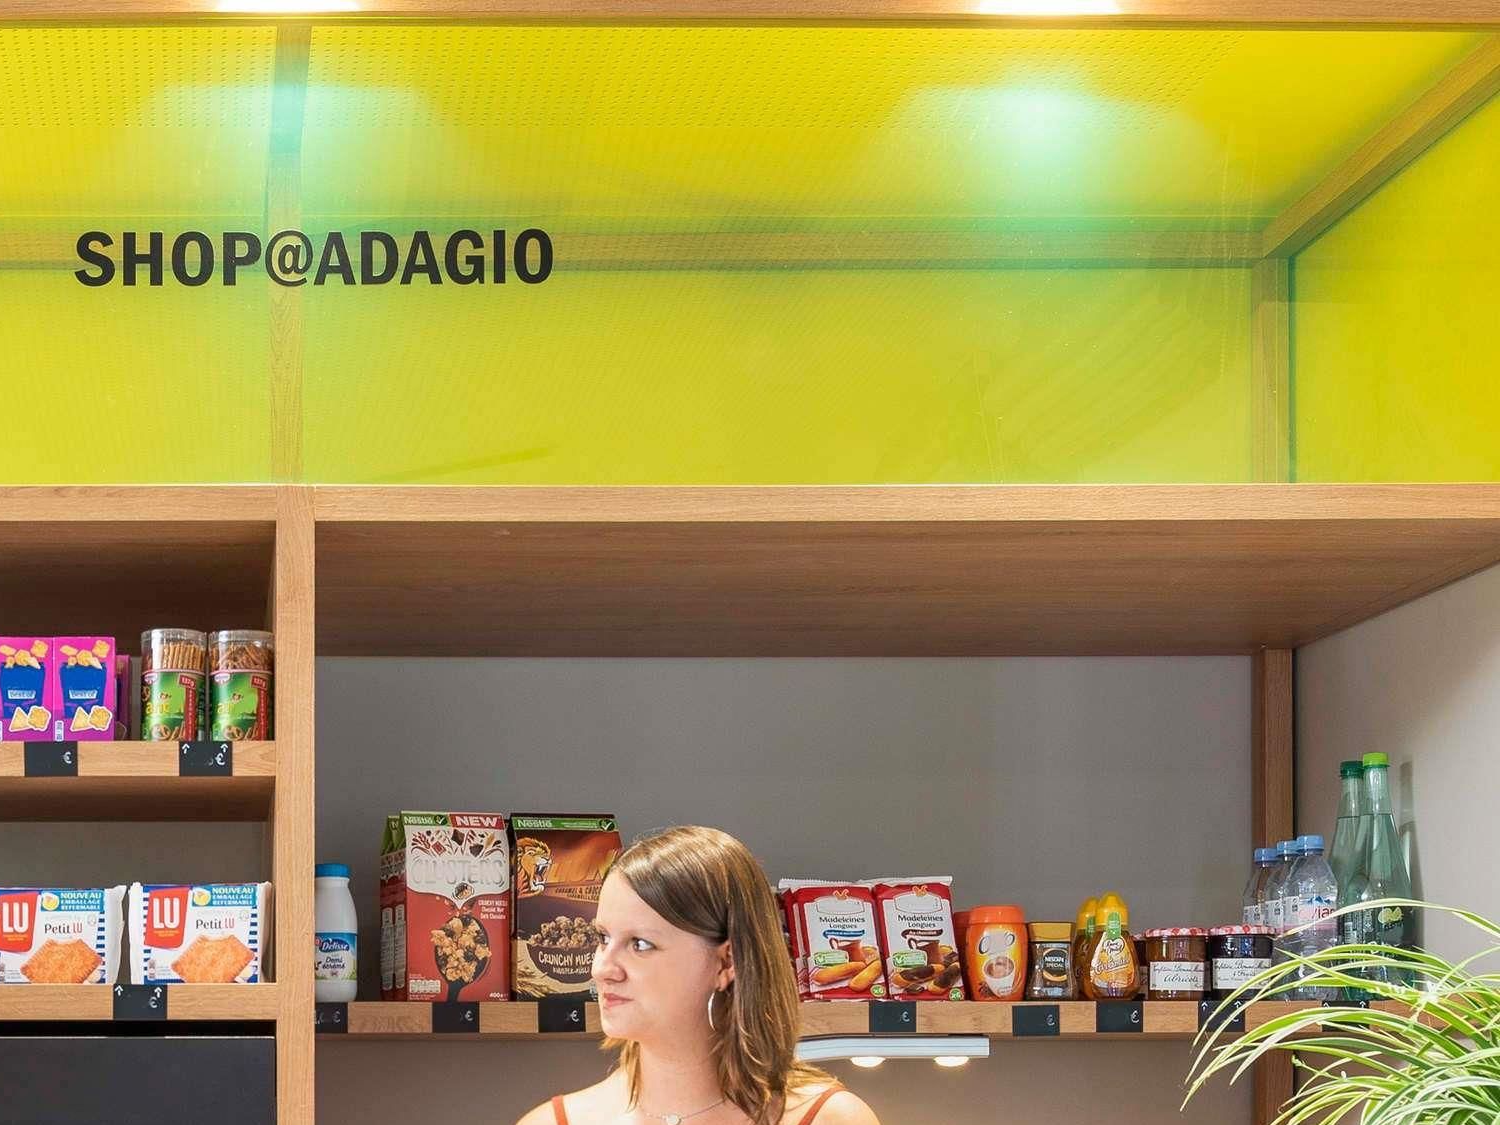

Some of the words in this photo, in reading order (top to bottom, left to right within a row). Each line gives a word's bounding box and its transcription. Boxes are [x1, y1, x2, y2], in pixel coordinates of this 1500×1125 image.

[74, 229, 554, 288] SHOP@ADAGIO
[456, 816, 498, 827] NEW
[2, 901, 29, 933] LU
[153, 897, 180, 929] LU
[898, 914, 944, 922] Madeleines
[44, 923, 70, 934] Petit
[73, 922, 83, 933] LU
[196, 919, 222, 929] Petit
[225, 917, 235, 929] LU
[538, 951, 573, 967] CRUNCHY
[576, 952, 595, 966] MUES
